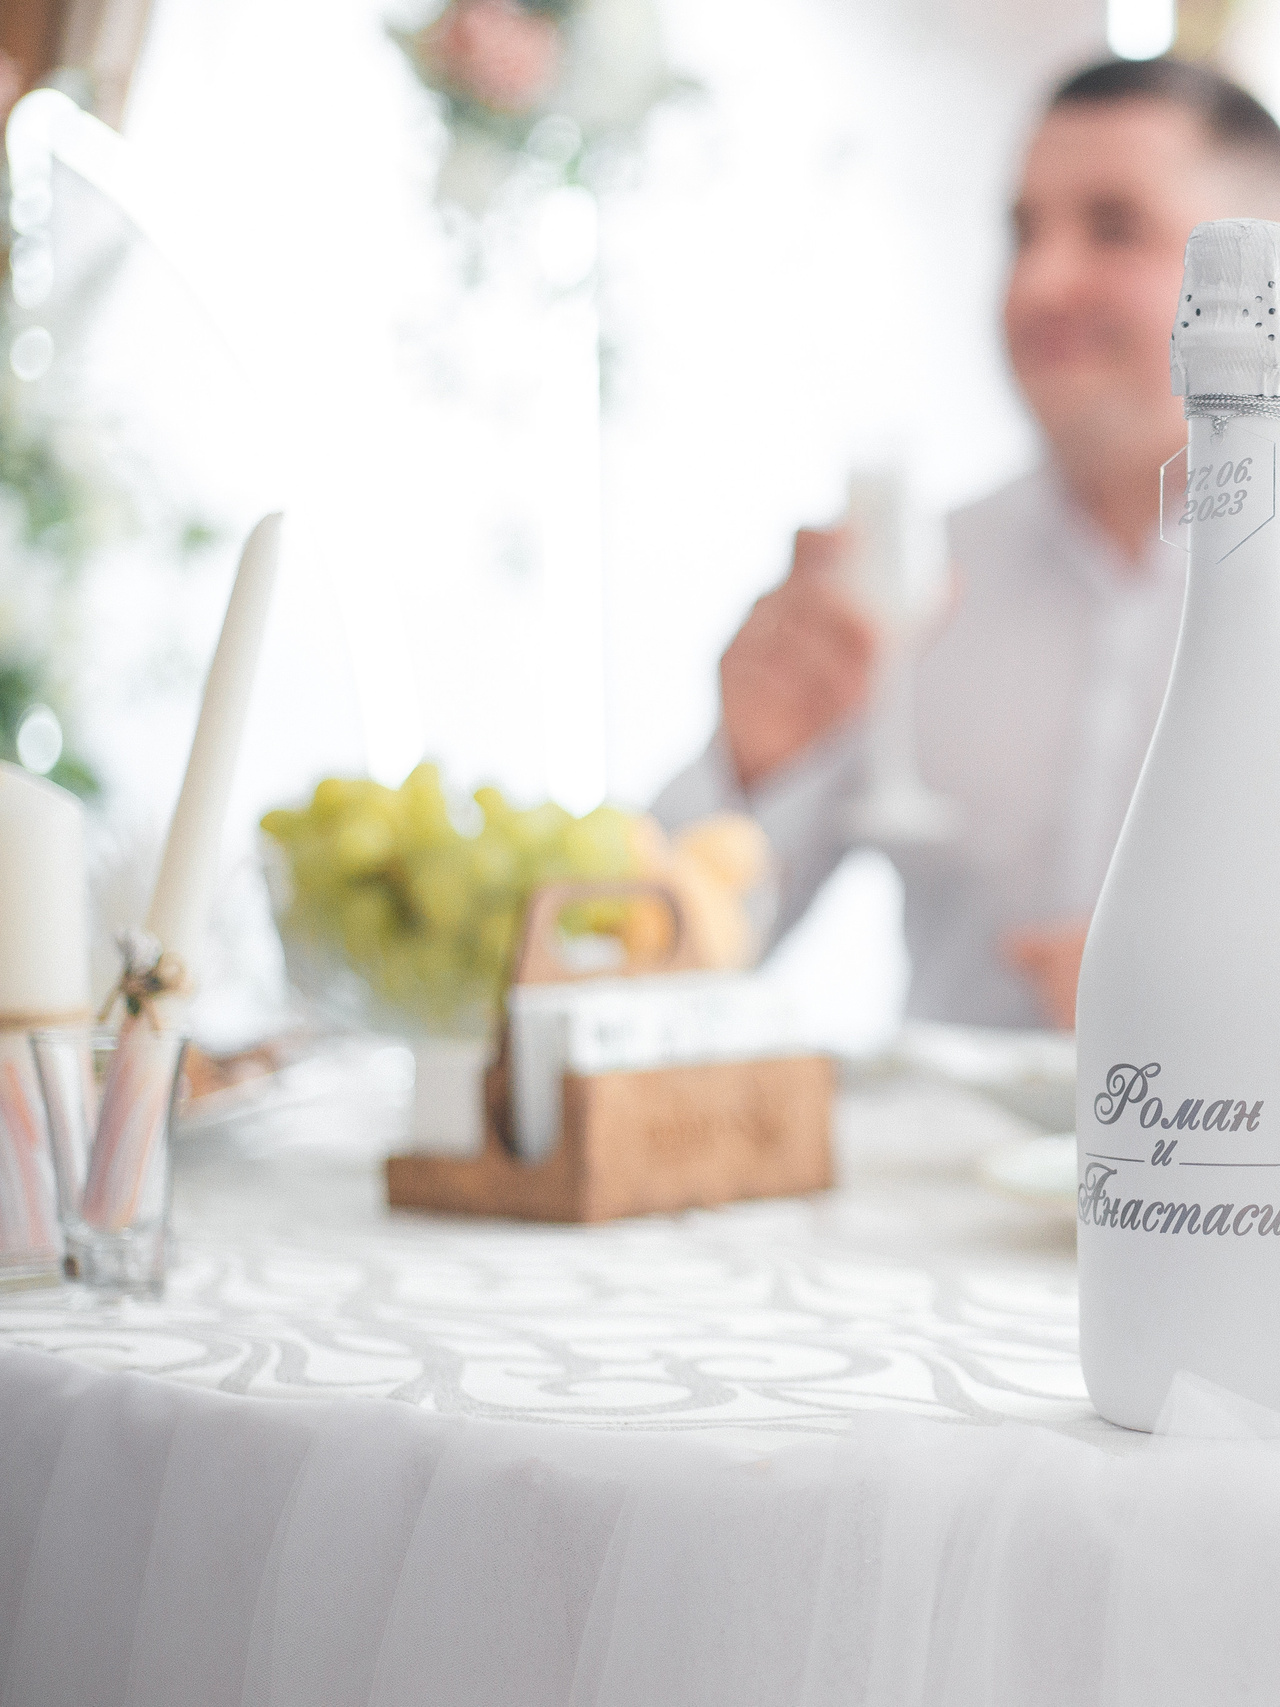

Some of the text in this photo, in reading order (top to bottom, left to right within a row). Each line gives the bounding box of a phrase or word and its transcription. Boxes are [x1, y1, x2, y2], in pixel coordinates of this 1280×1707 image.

[1178, 489, 1247, 526] 2023
[1094, 1062, 1264, 1132] Роман
[1151, 1139, 1178, 1166] и
